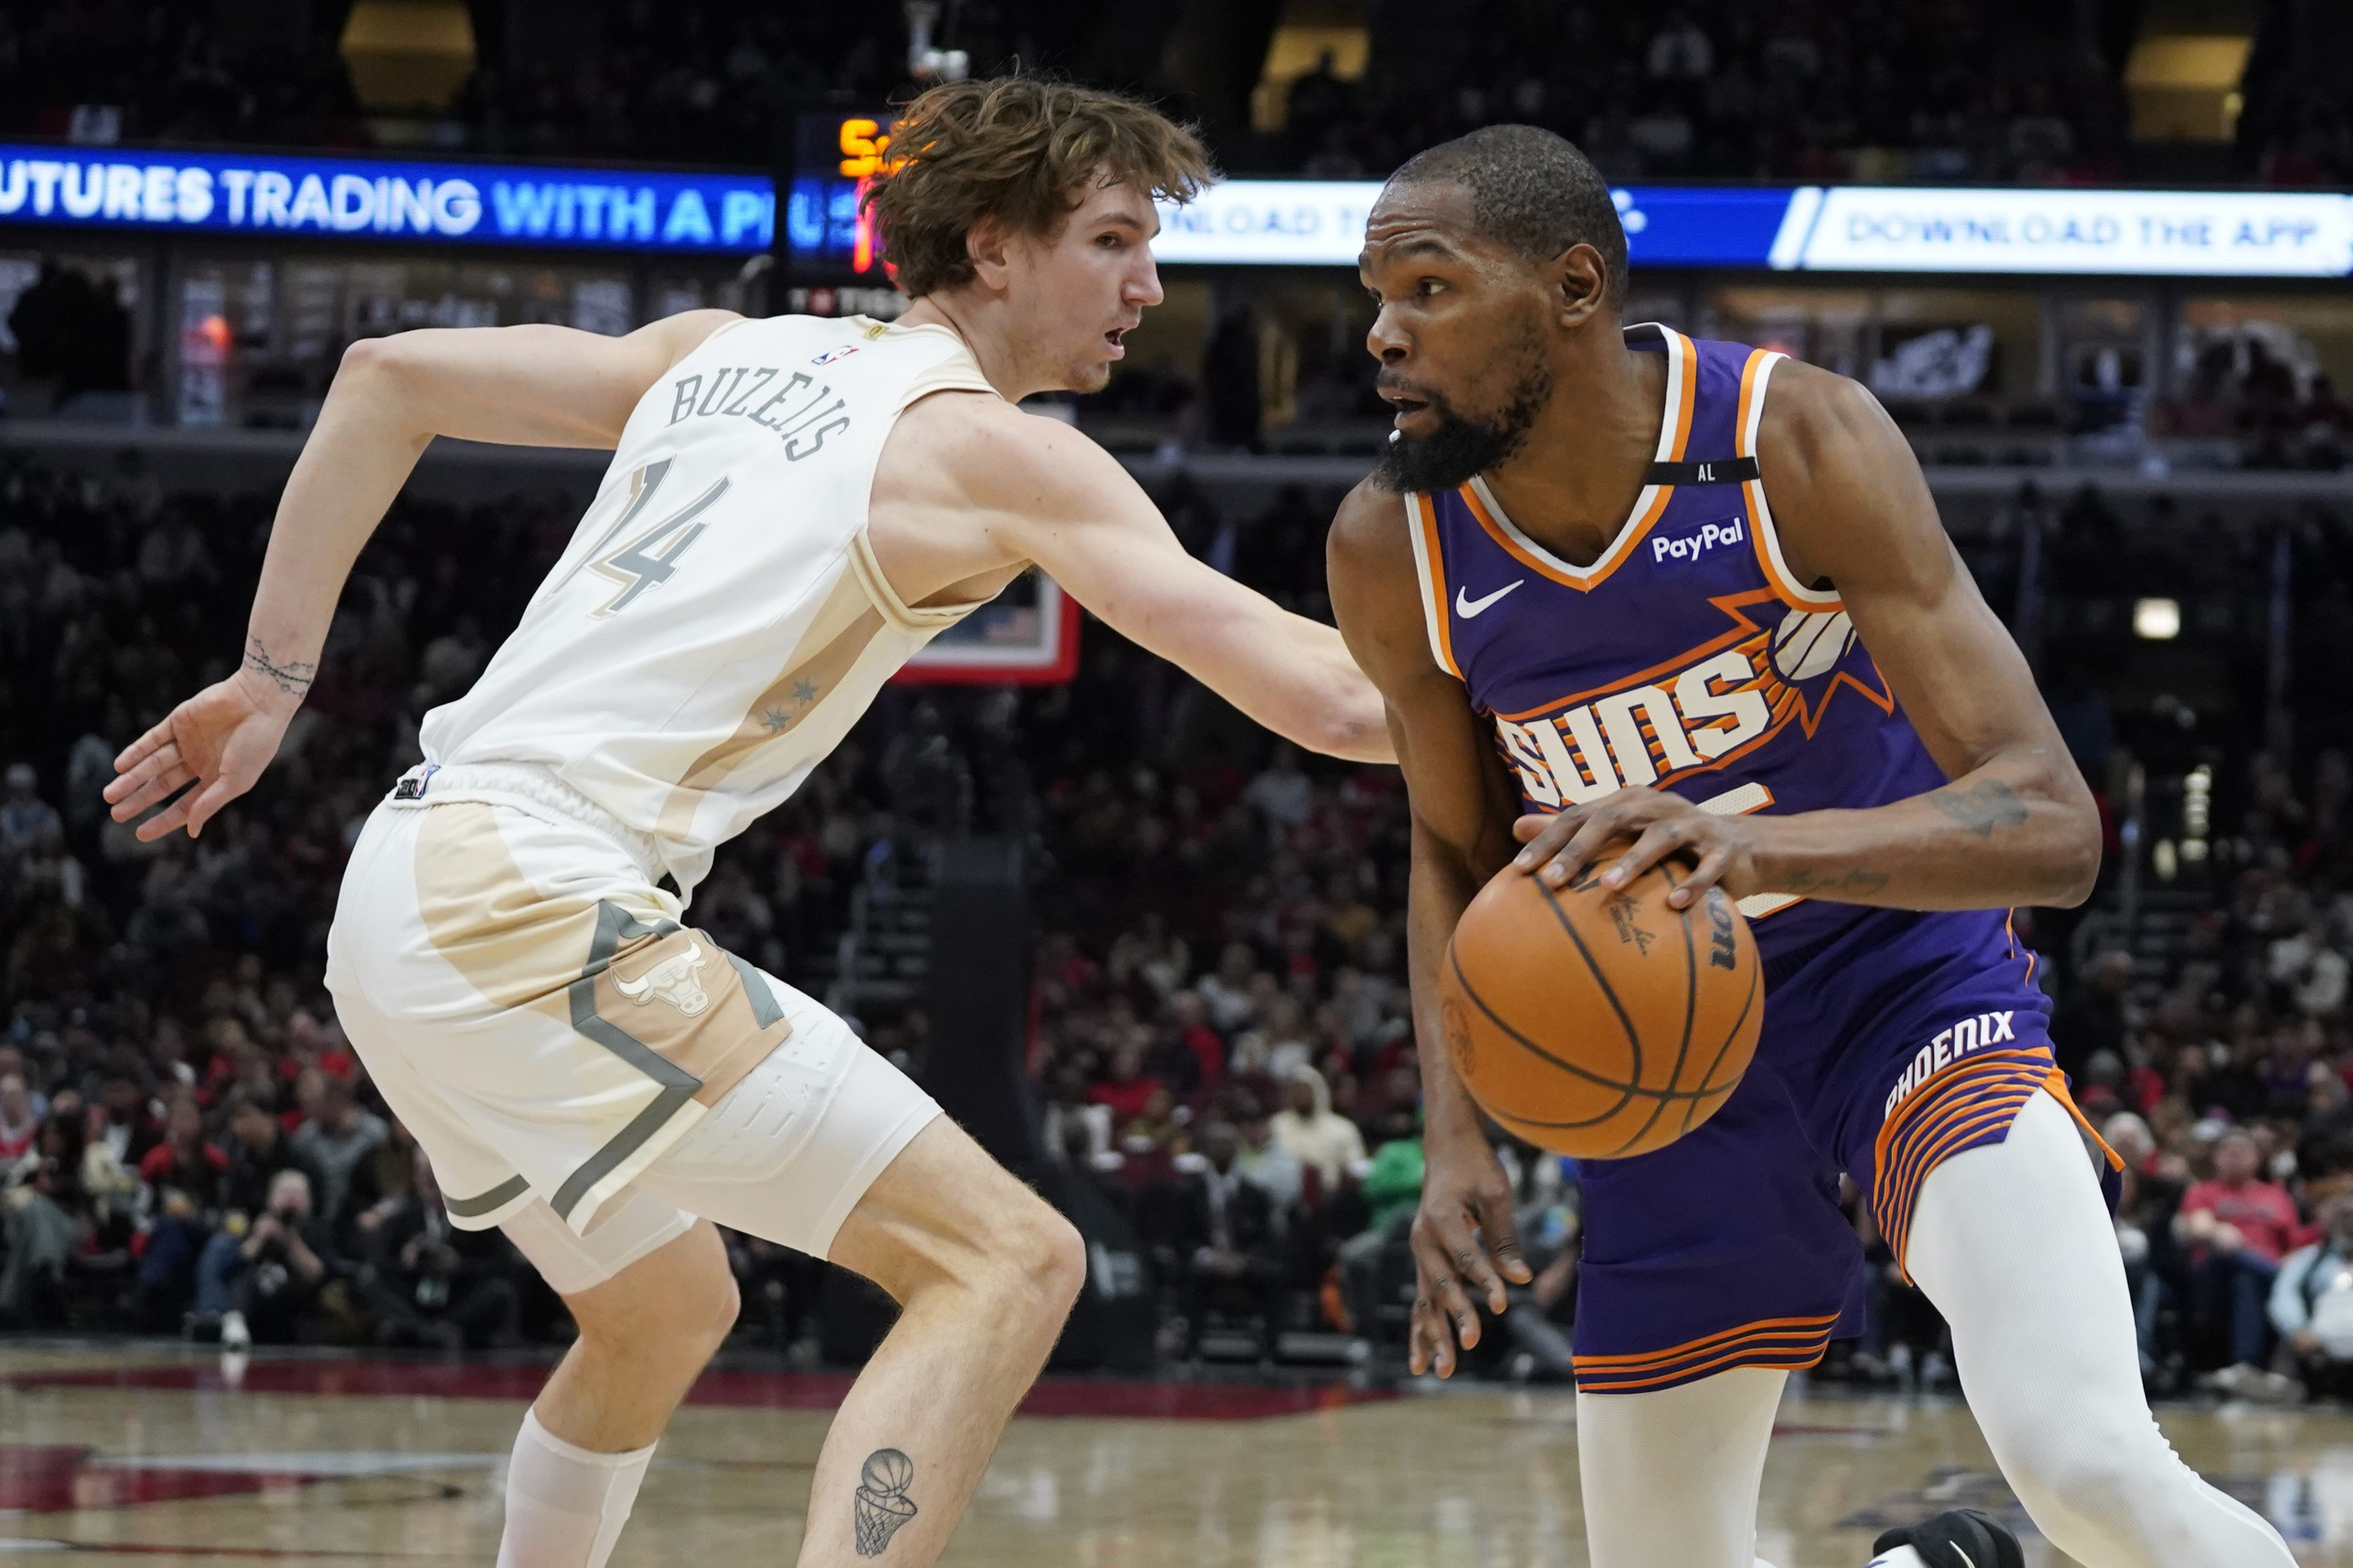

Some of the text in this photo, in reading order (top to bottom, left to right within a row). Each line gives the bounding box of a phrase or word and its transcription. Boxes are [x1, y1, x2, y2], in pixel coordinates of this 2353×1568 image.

[218, 169, 482, 235] TRADING
[492, 181, 656, 242] WITH
[663, 189, 713, 245] A
[1846, 210, 2319, 248] DOWNLOAD THE APP
[1697, 463, 1716, 482] AL
[538, 454, 731, 619] 14
[1652, 517, 1743, 563] PayPal
[1497, 649, 1769, 808] SUNS
[1885, 1010, 2016, 1122] PHOENIX
